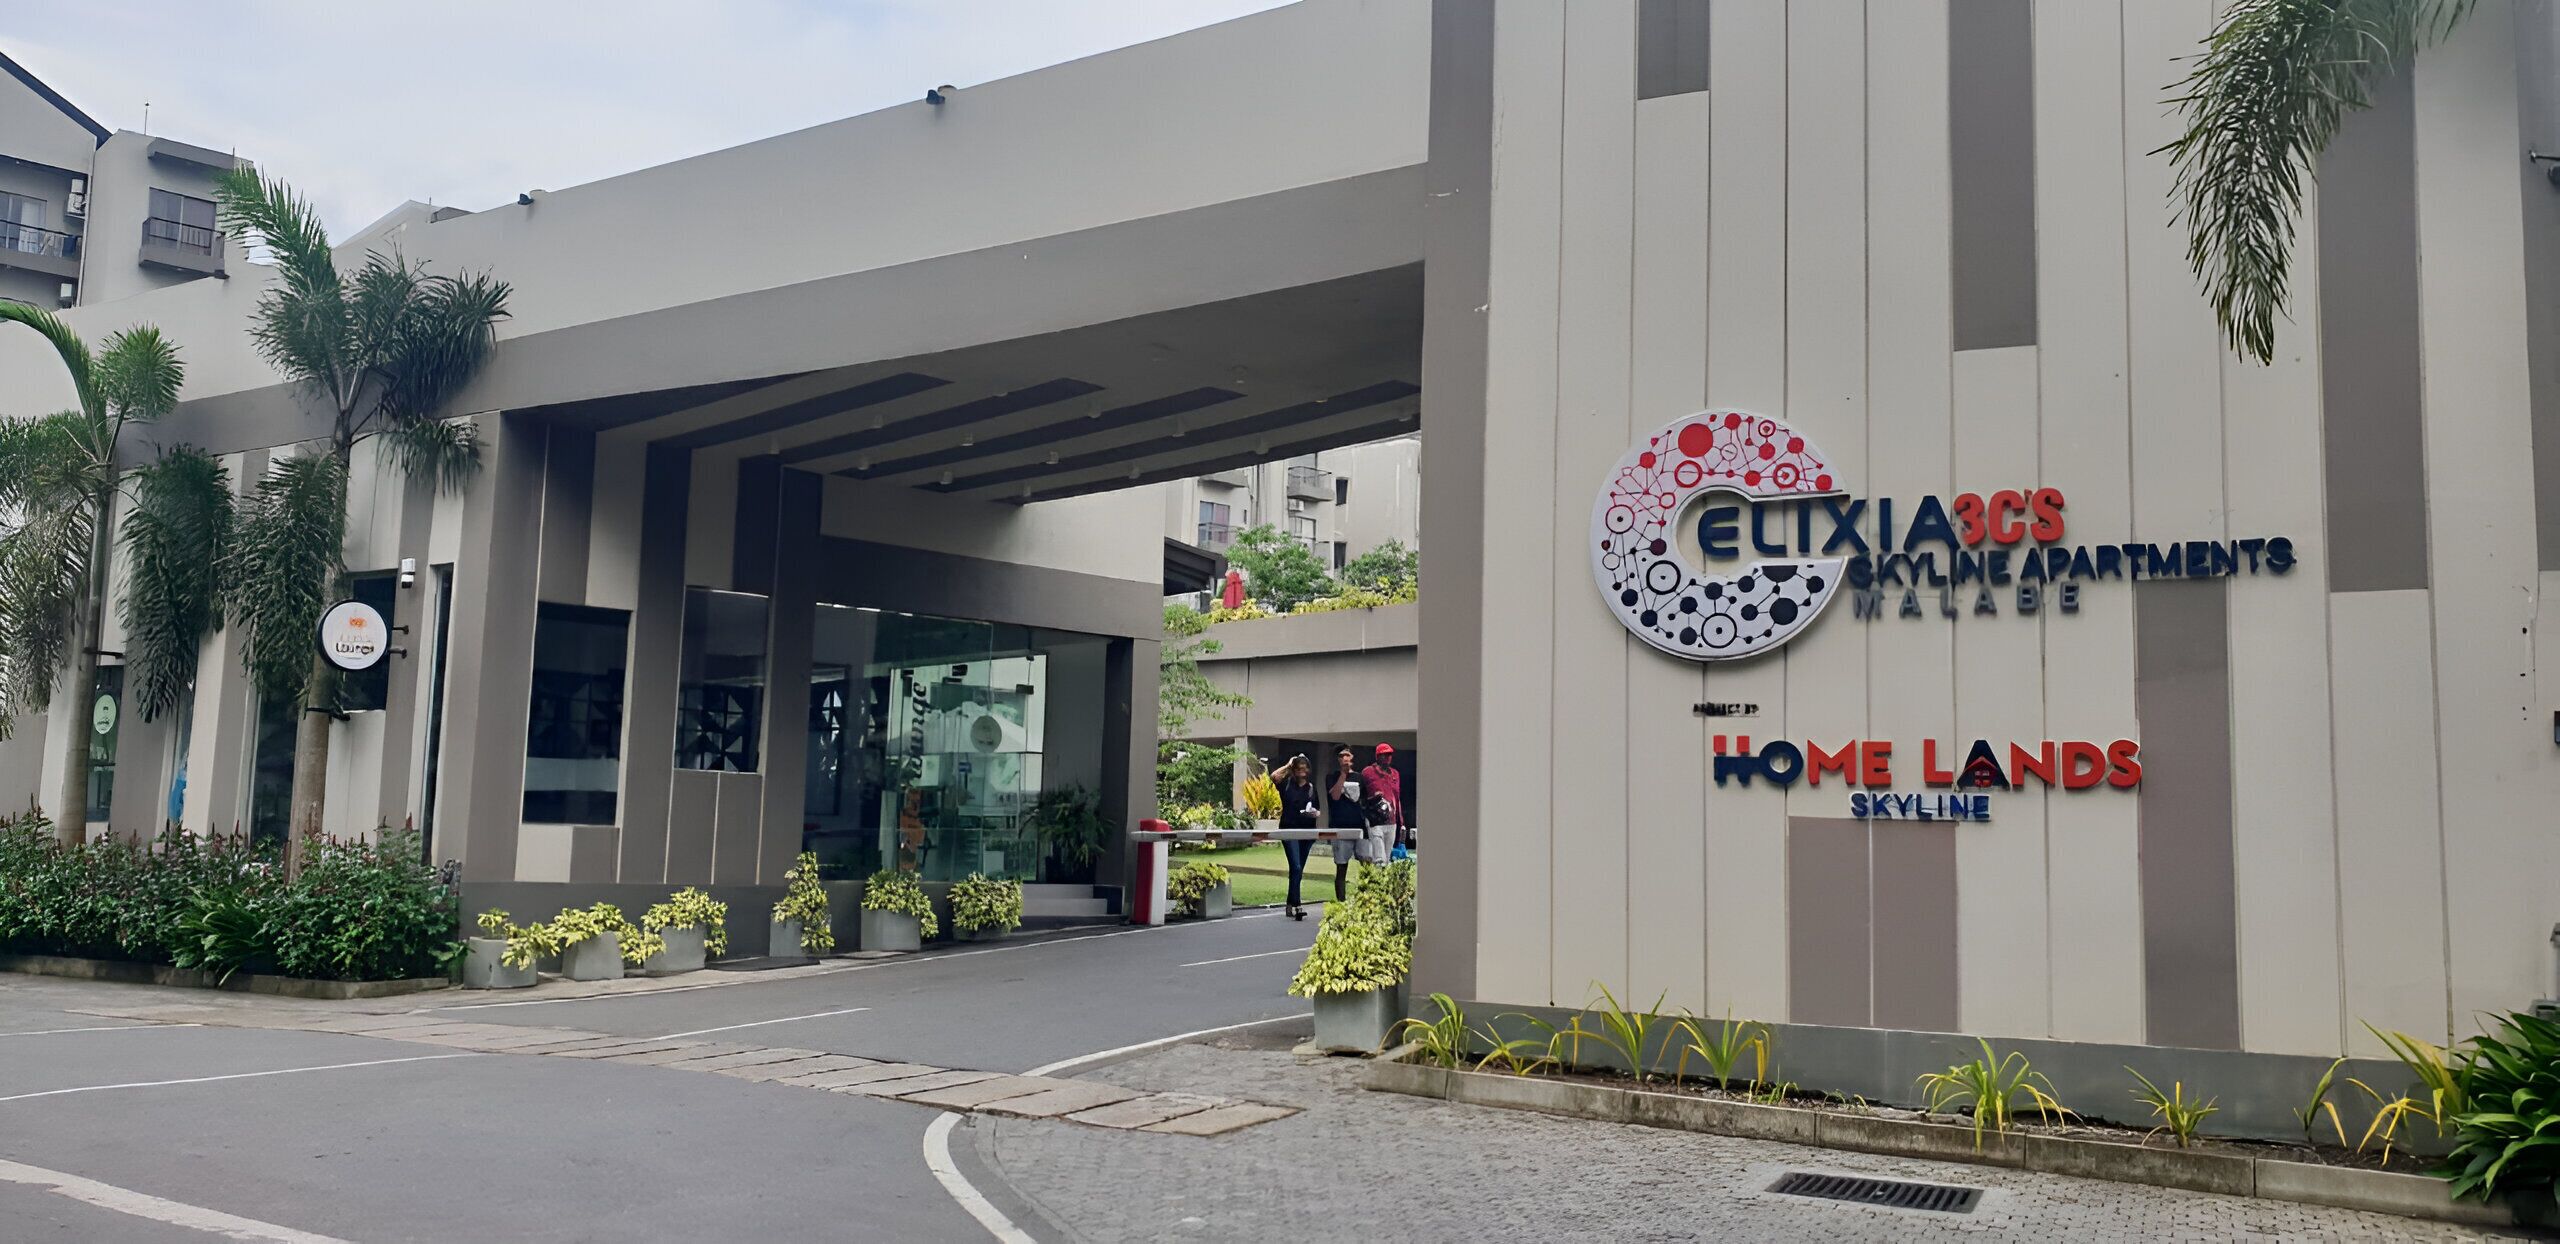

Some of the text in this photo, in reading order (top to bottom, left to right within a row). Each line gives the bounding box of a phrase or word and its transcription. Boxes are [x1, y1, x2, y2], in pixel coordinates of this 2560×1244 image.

[1697, 495, 1961, 557] ELIXIA
[1848, 536, 2298, 589] SKYLINE APARTMENTS
[1853, 580, 2080, 619] MALABE
[1713, 735, 2142, 789] HOME LANDS
[1850, 793, 1991, 820] SKYLINE
